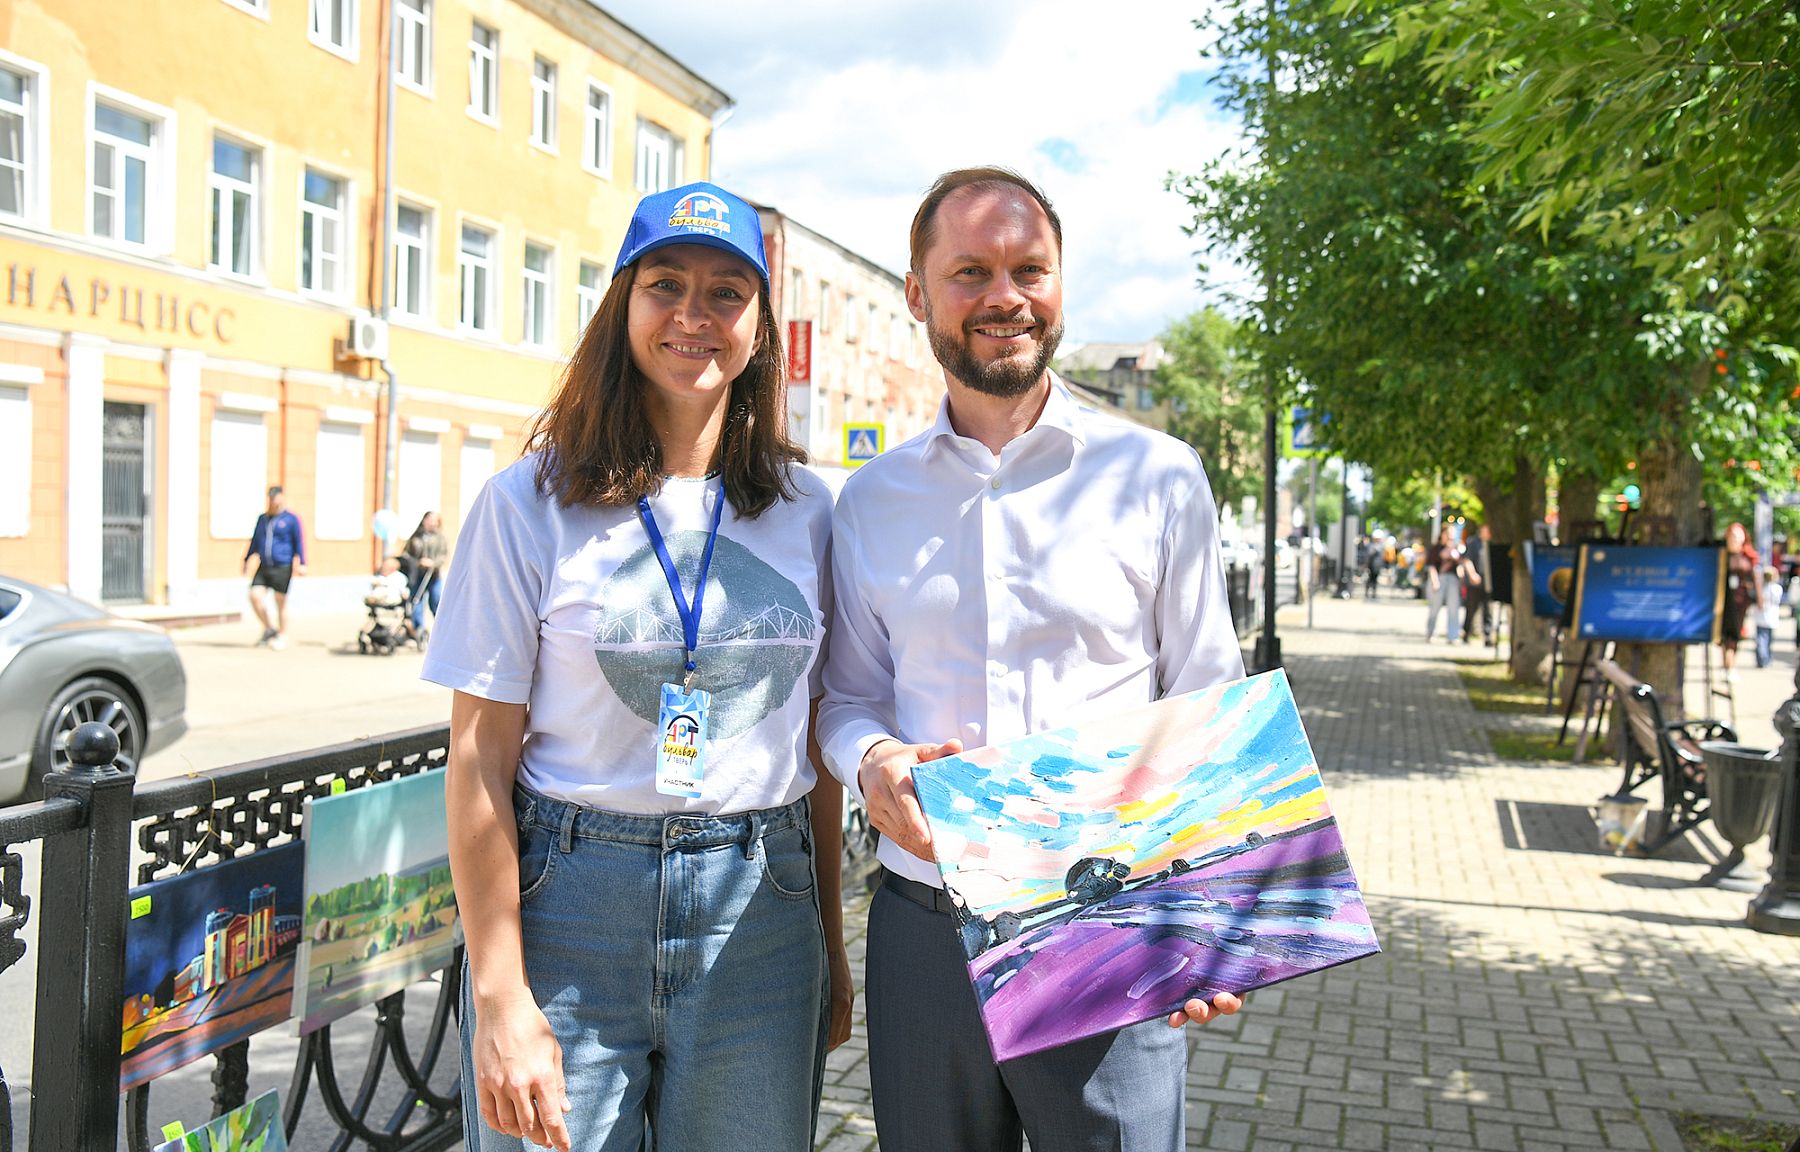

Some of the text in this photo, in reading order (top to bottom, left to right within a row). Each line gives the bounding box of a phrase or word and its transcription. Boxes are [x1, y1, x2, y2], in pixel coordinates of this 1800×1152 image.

[671, 199, 729, 221] АРТ
[7, 262, 237, 344] НАРЦИСС
[664, 723, 699, 745] АРТ
[663, 778, 695, 788] УЧАСТНИК
